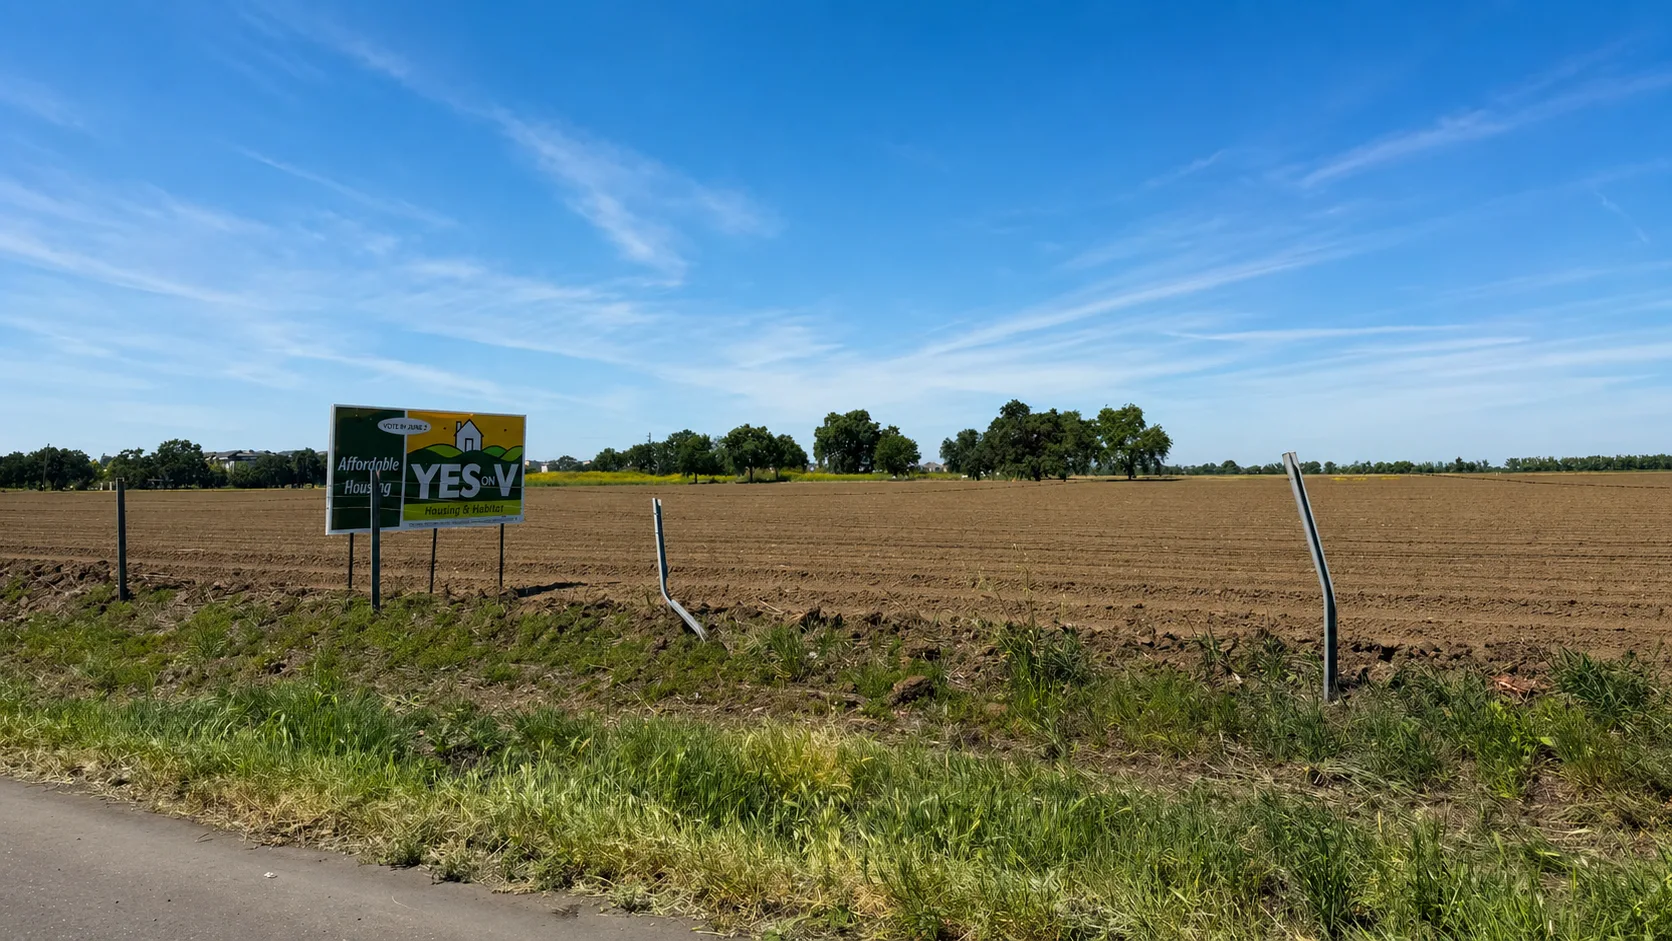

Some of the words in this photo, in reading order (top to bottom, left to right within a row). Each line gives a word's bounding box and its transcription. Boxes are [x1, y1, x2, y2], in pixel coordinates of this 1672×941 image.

[337, 456, 400, 471] Affordable
[344, 479, 392, 497] Housng
[411, 463, 481, 499] YES
[481, 476, 495, 486] ON
[494, 464, 519, 497] V
[425, 505, 461, 516] Housing
[462, 505, 470, 515] &
[473, 504, 504, 513] Habitat
